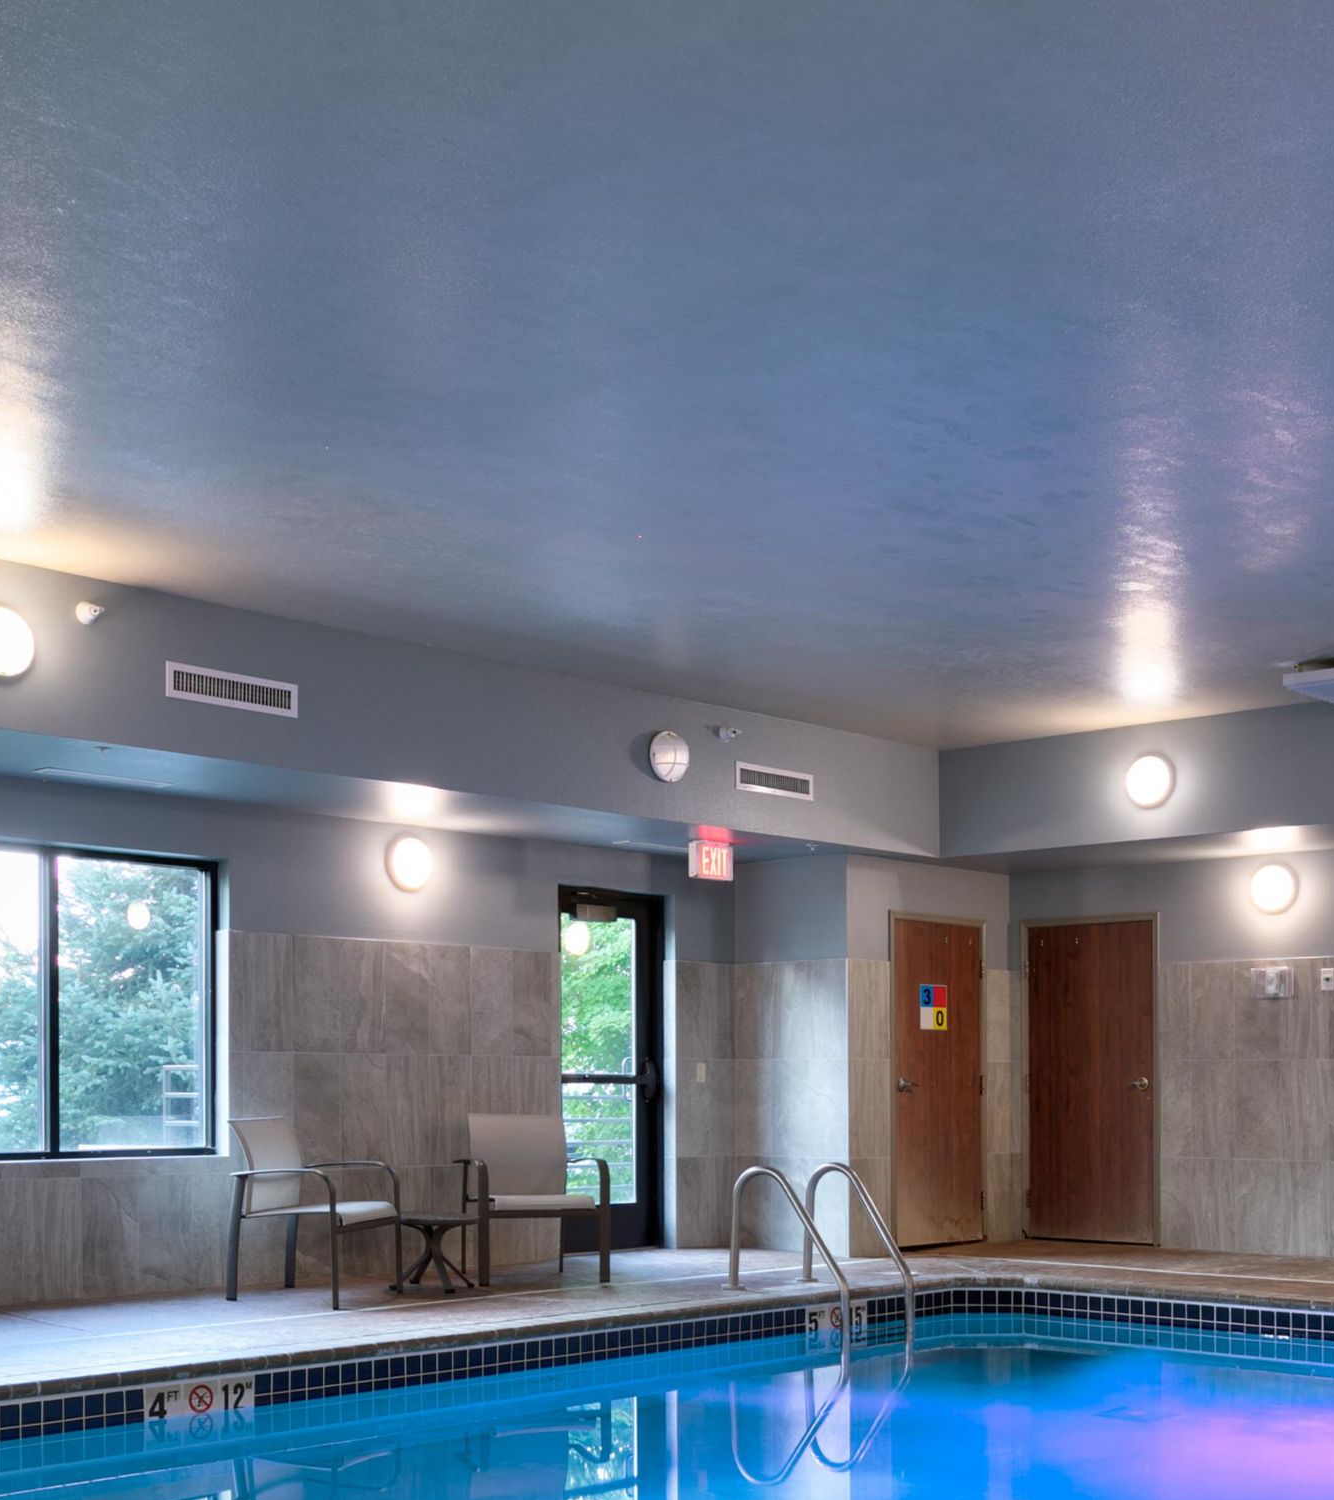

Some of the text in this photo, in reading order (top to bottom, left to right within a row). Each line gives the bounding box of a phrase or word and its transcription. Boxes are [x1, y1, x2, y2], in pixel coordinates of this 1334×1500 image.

[702, 846, 728, 877] EXIT
[923, 988, 932, 1005] 3
[936, 1010, 944, 1026] 0
